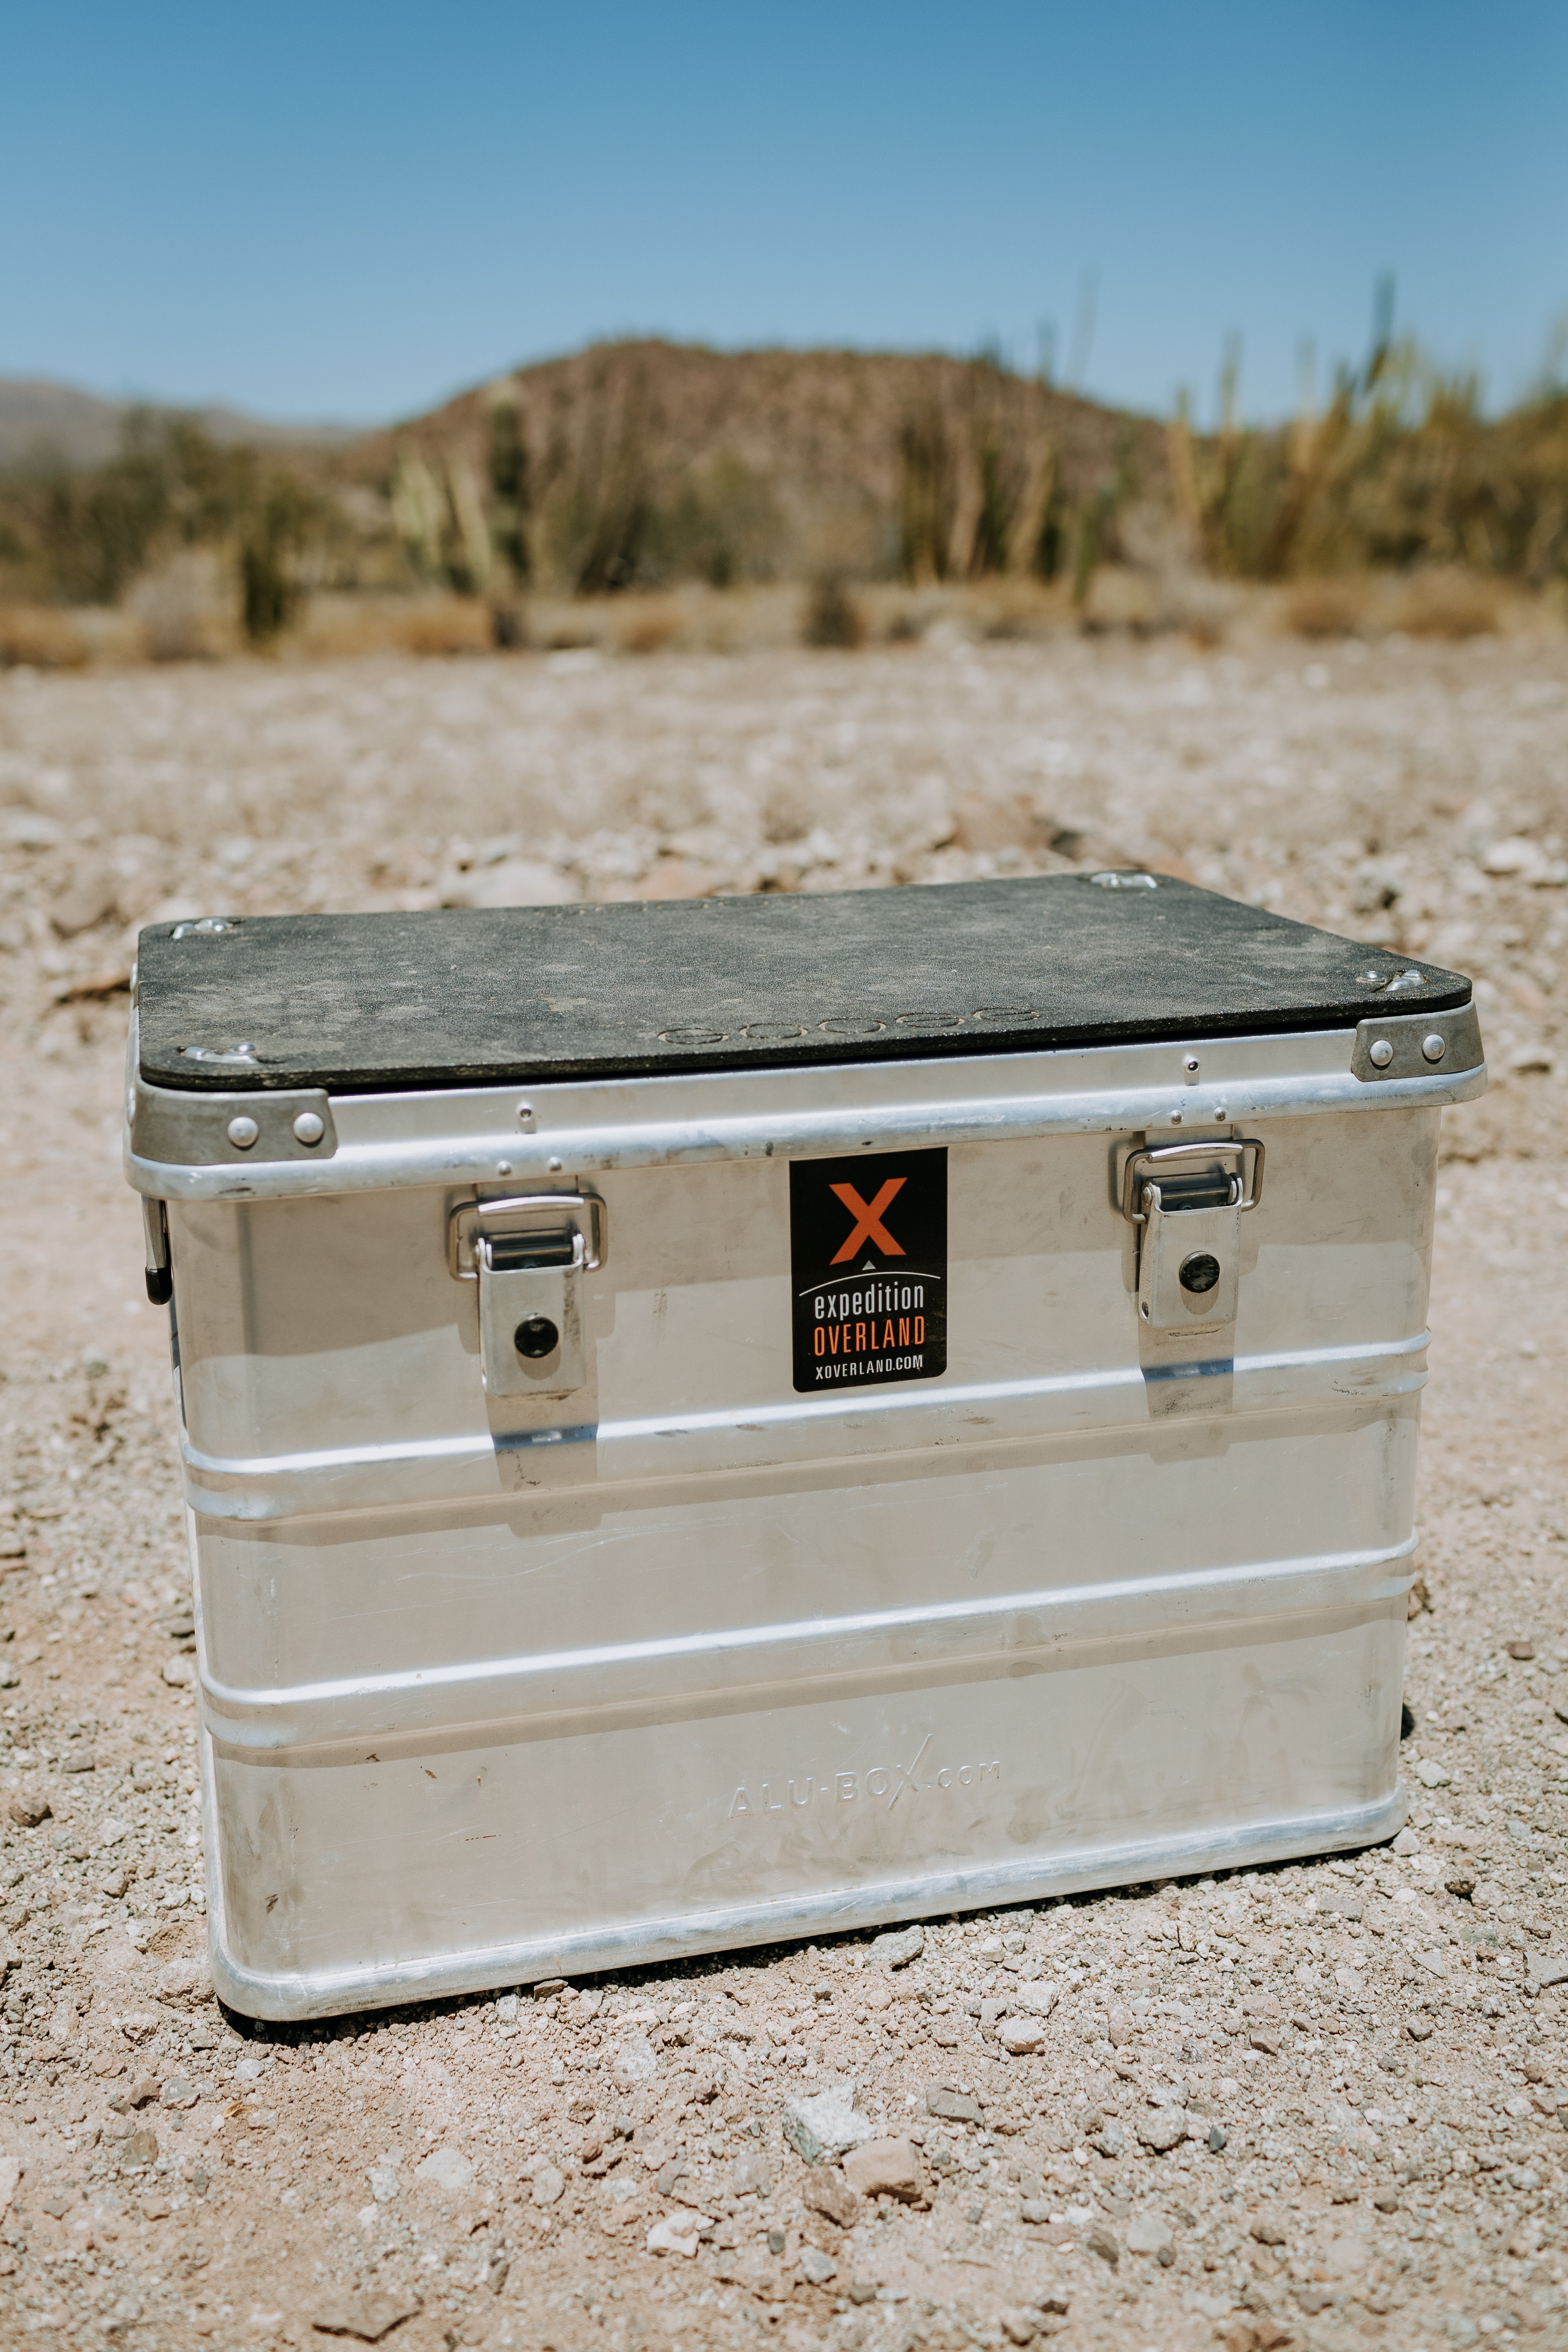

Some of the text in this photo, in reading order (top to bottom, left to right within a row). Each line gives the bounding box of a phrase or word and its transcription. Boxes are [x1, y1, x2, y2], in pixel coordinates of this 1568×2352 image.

[829, 1178, 908, 1265] X
[815, 1281, 924, 1320] expedition
[814, 1316, 924, 1356] OVERLAND
[815, 1355, 923, 1380] XOVERLAND.COM
